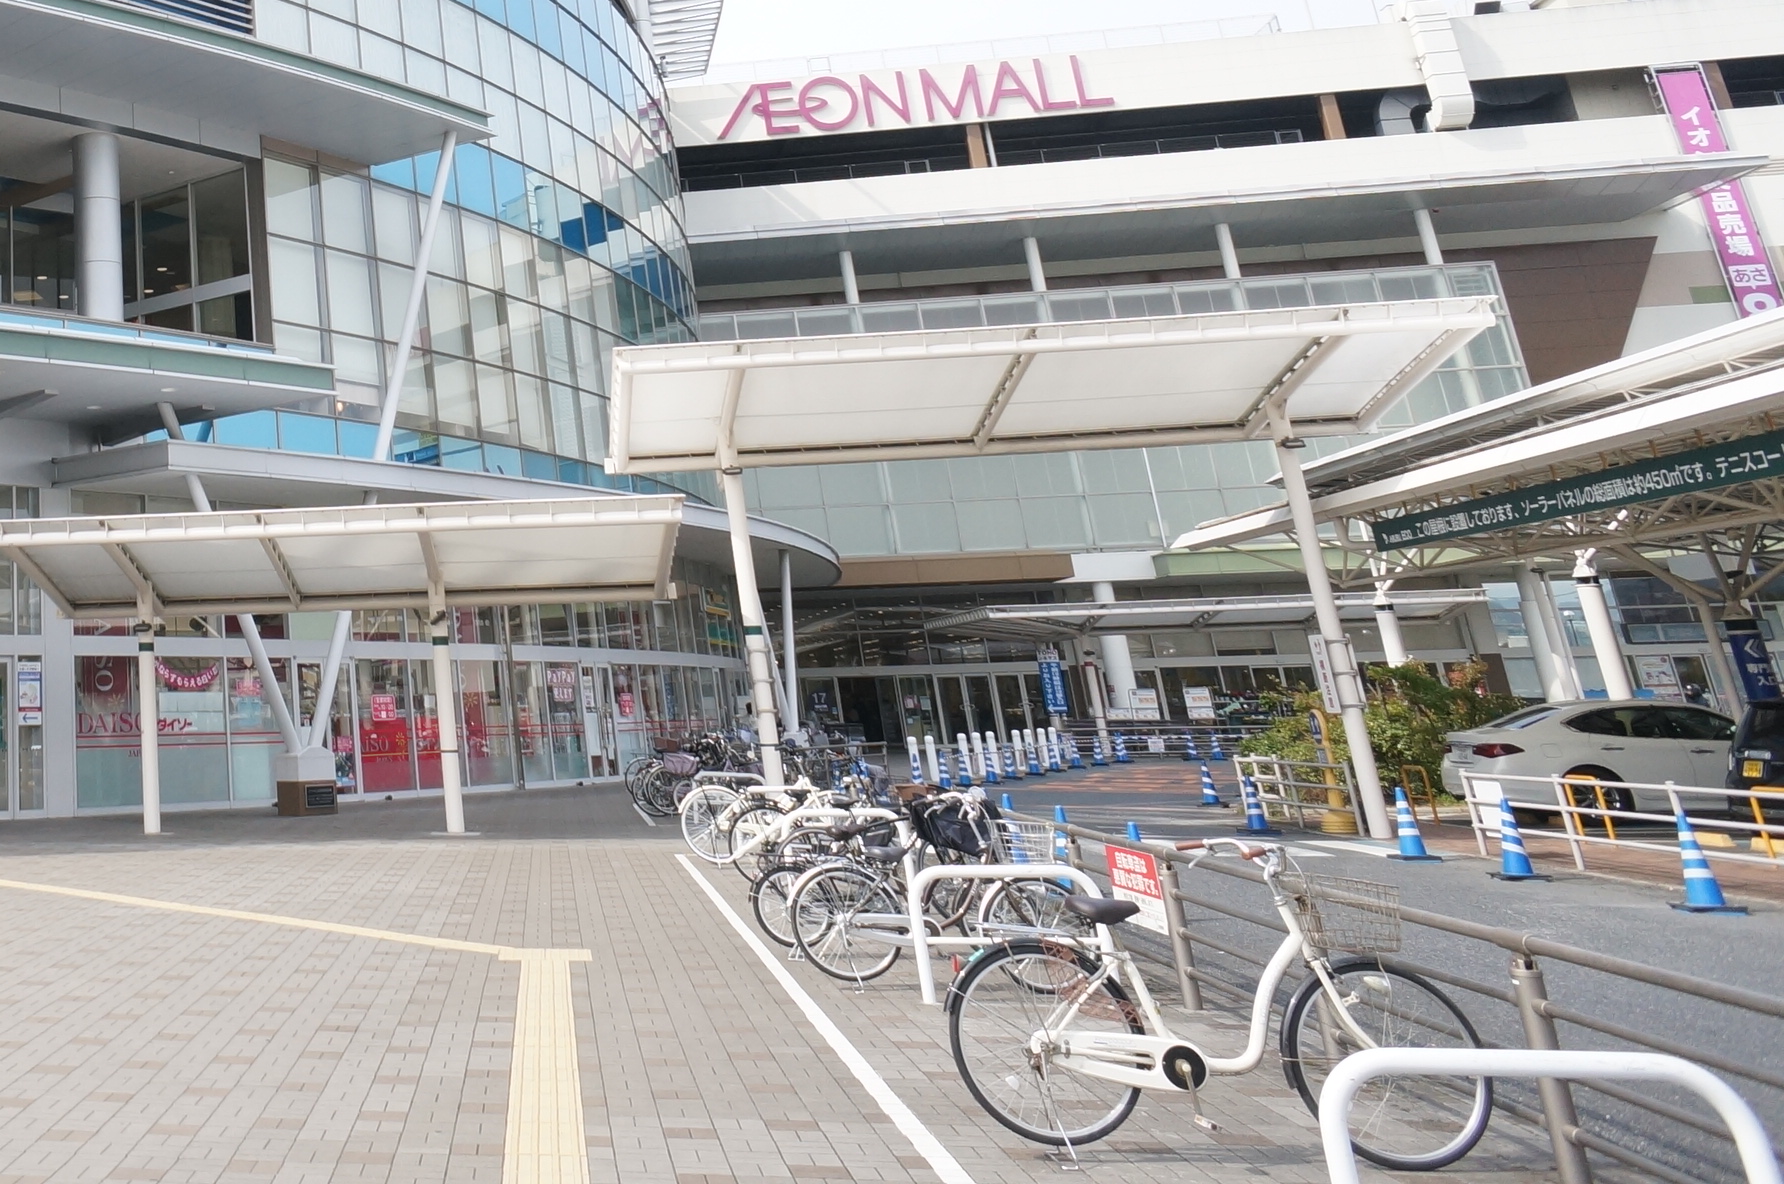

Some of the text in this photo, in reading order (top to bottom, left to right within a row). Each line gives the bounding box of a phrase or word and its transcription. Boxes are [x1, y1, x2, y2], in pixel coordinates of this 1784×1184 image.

[919, 55, 1115, 122] MALL
[1732, 269, 1768, 282] あさ
[812, 692, 827, 703] 17
